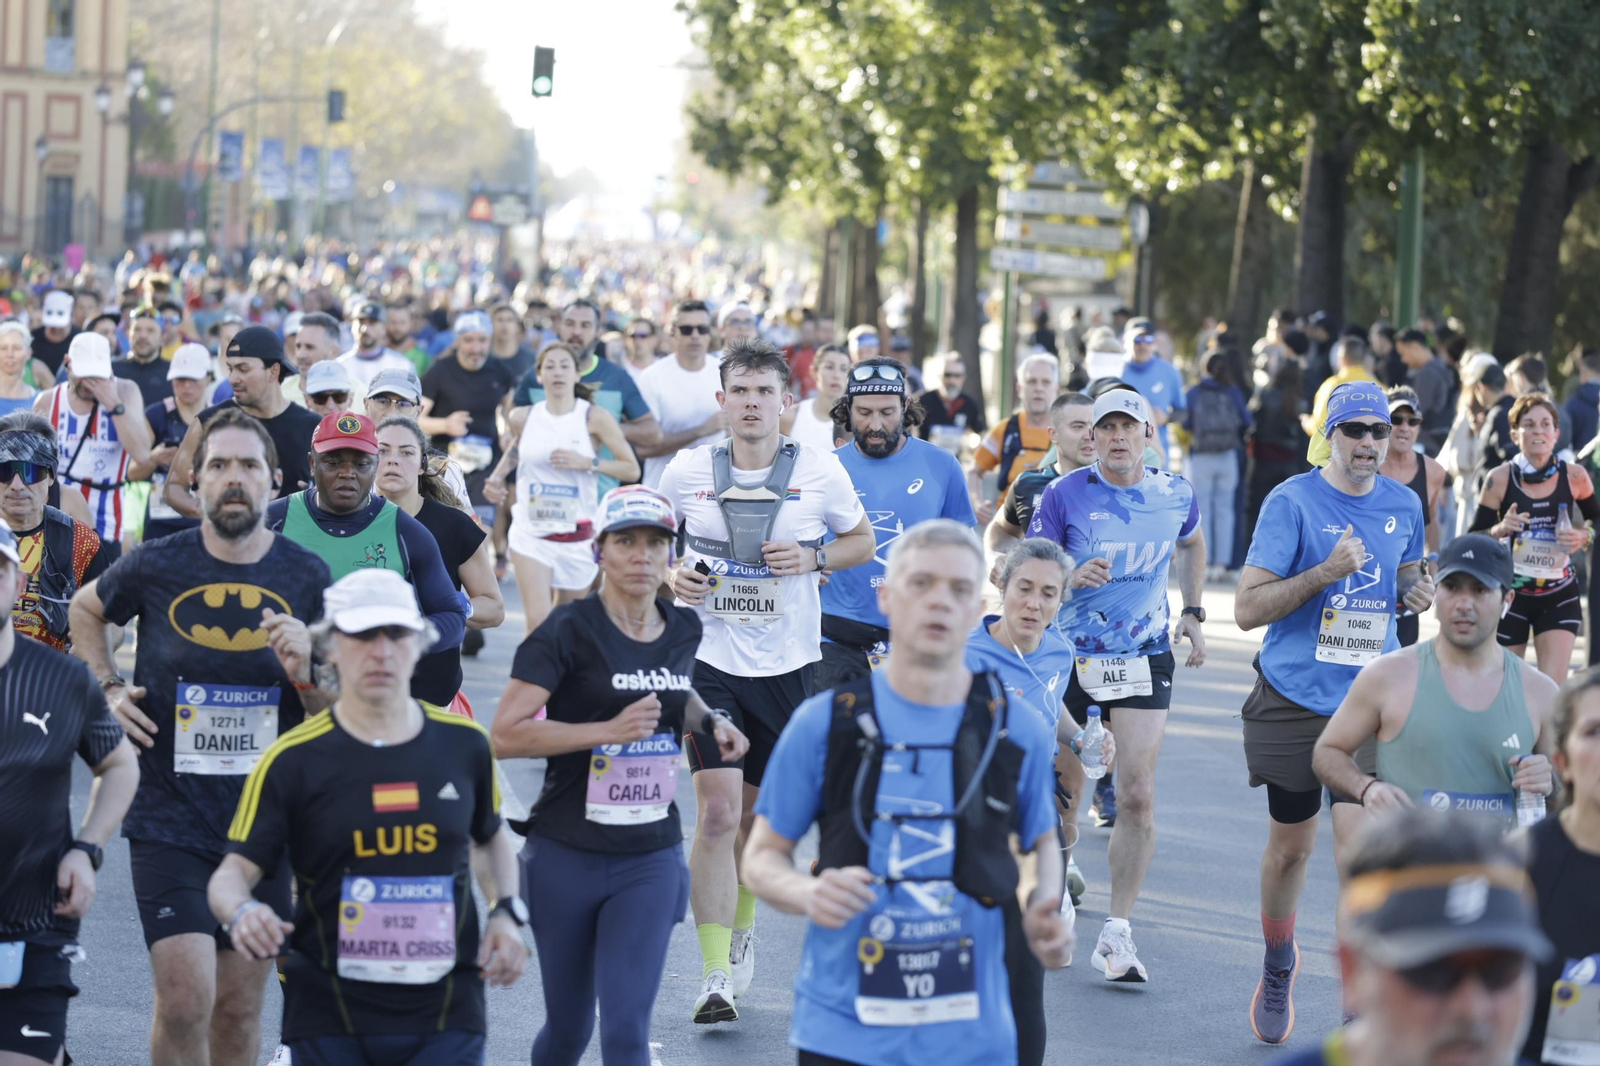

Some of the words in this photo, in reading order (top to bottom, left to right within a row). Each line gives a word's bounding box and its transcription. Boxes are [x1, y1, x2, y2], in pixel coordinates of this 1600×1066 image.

[1523, 554, 1555, 568] JAYGO
[731, 584, 759, 595] 11655
[714, 597, 775, 612] LINCOLN
[1351, 598, 1386, 610] ZURICH
[1347, 619, 1371, 630] 10462
[1318, 634, 1344, 648] DANI
[1347, 638, 1384, 651] DORREG
[1100, 658, 1126, 667] 11448
[1103, 669, 1127, 684] ALE
[212, 690, 268, 704] ZURICH
[210, 716, 246, 729] 12714
[194, 733, 259, 752] DANIEL
[627, 739, 674, 754] ZURICH
[608, 783, 661, 801] CARLA
[1456, 798, 1504, 812] ZURICH
[353, 823, 438, 858] LUIS
[380, 884, 443, 899] ZURICH
[900, 918, 962, 939] ZURICH
[339, 939, 400, 958] MARTA
[902, 973, 935, 998] YO
